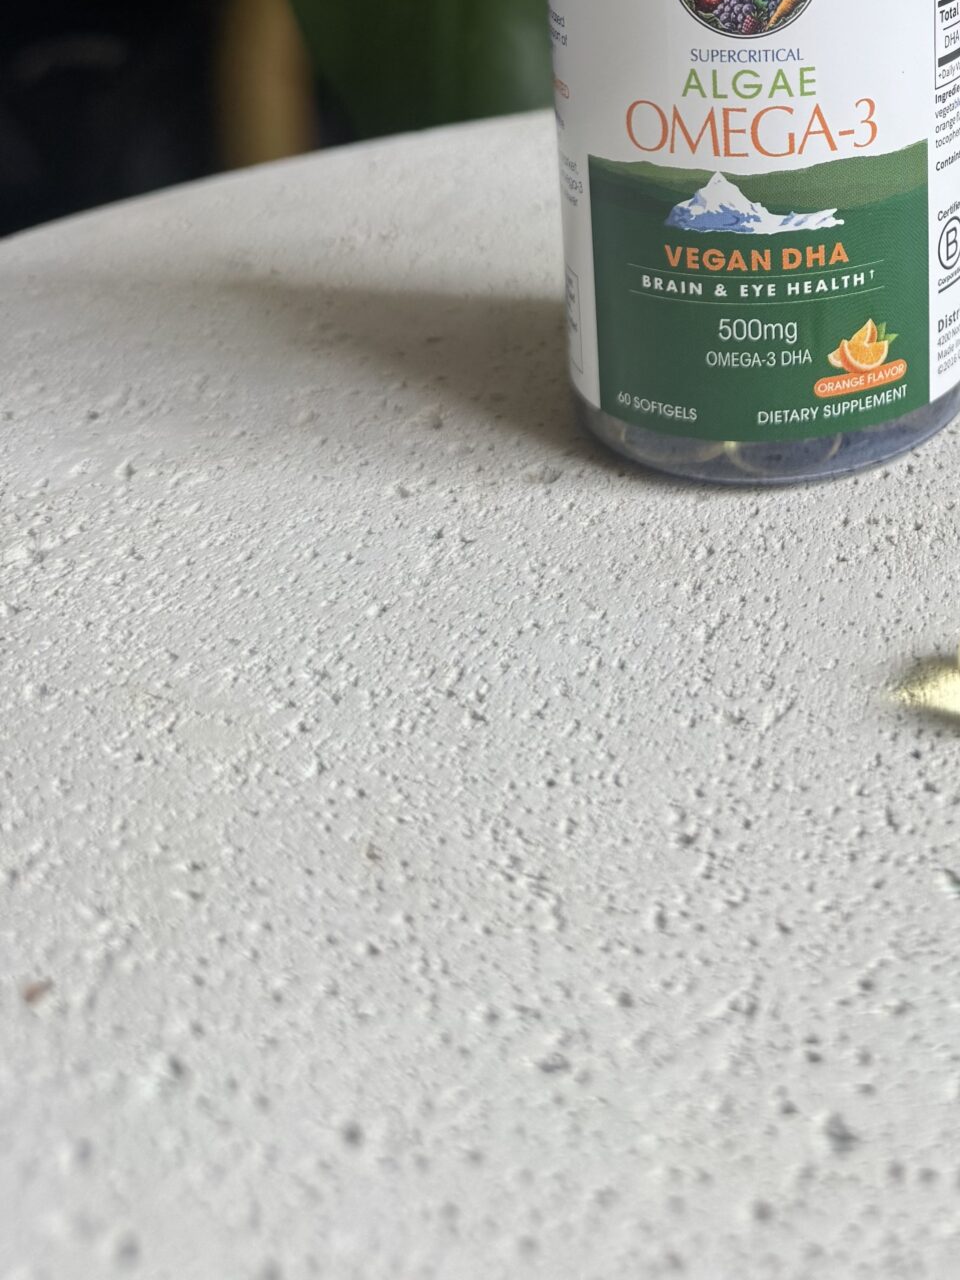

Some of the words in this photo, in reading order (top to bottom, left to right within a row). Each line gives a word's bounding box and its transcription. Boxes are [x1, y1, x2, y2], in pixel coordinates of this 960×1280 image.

[940, 2, 959, 23] Total
[945, 29, 960, 49] DHA
[690, 48, 804, 63] SUPERCRITICAL
[681, 66, 817, 99] ALGAE
[625, 99, 878, 157] OMEGA-3
[664, 244, 772, 272] VEGAN
[782, 242, 850, 270] DHA
[642, 274, 704, 296] BRAIN
[714, 283, 728, 297] &
[740, 282, 776, 297] EYE
[718, 318, 798, 343] 500mg
[706, 351, 778, 368] OMEGA-3
[781, 350, 813, 367] DHA
[938, 343, 955, 361] Made
[817, 373, 865, 394] ORANGE
[866, 364, 906, 387] FLAVOR
[618, 391, 631, 407] 60
[633, 396, 698, 421] SOFTGELS
[757, 406, 820, 424] DIETARY
[822, 384, 907, 418] SUPPLEMENT
